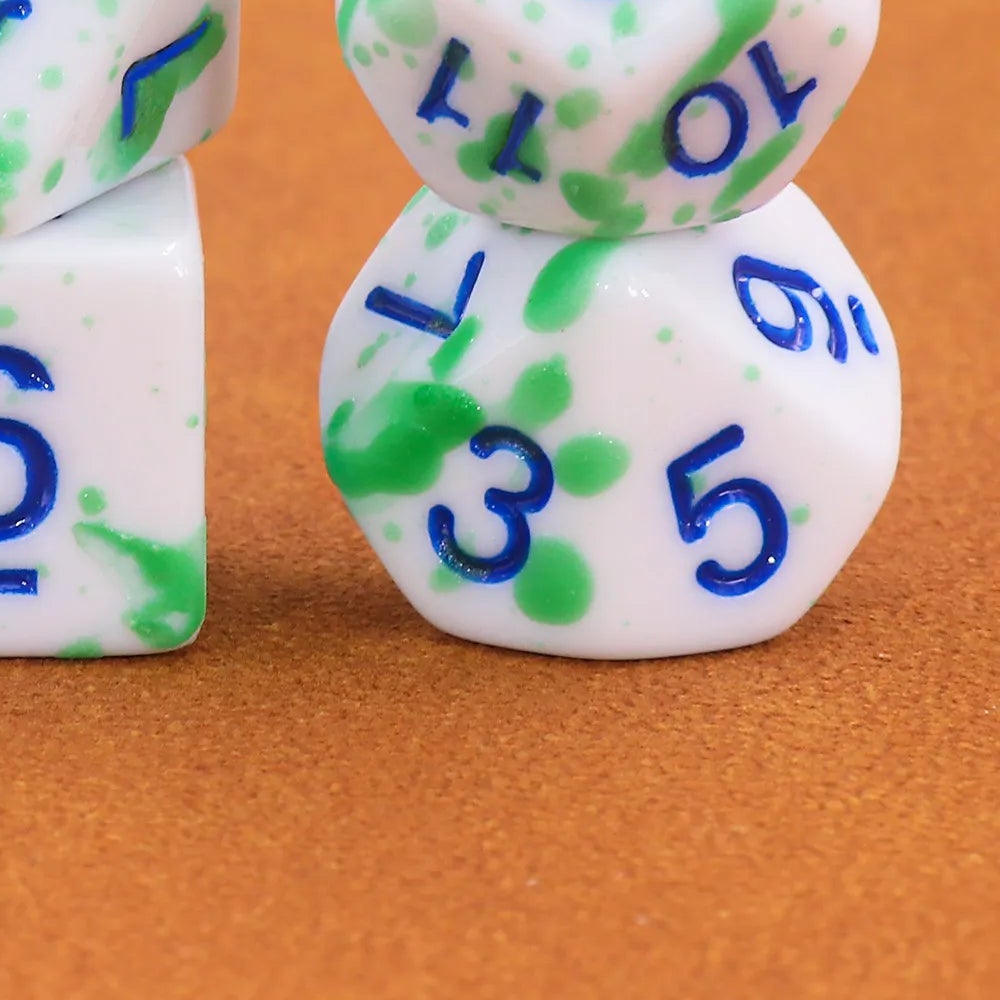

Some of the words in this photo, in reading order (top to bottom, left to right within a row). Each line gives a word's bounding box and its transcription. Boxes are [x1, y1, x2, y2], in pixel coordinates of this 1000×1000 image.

[662, 40, 818, 179] 10
[427, 424, 555, 586] 3
[666, 424, 790, 598] 5
